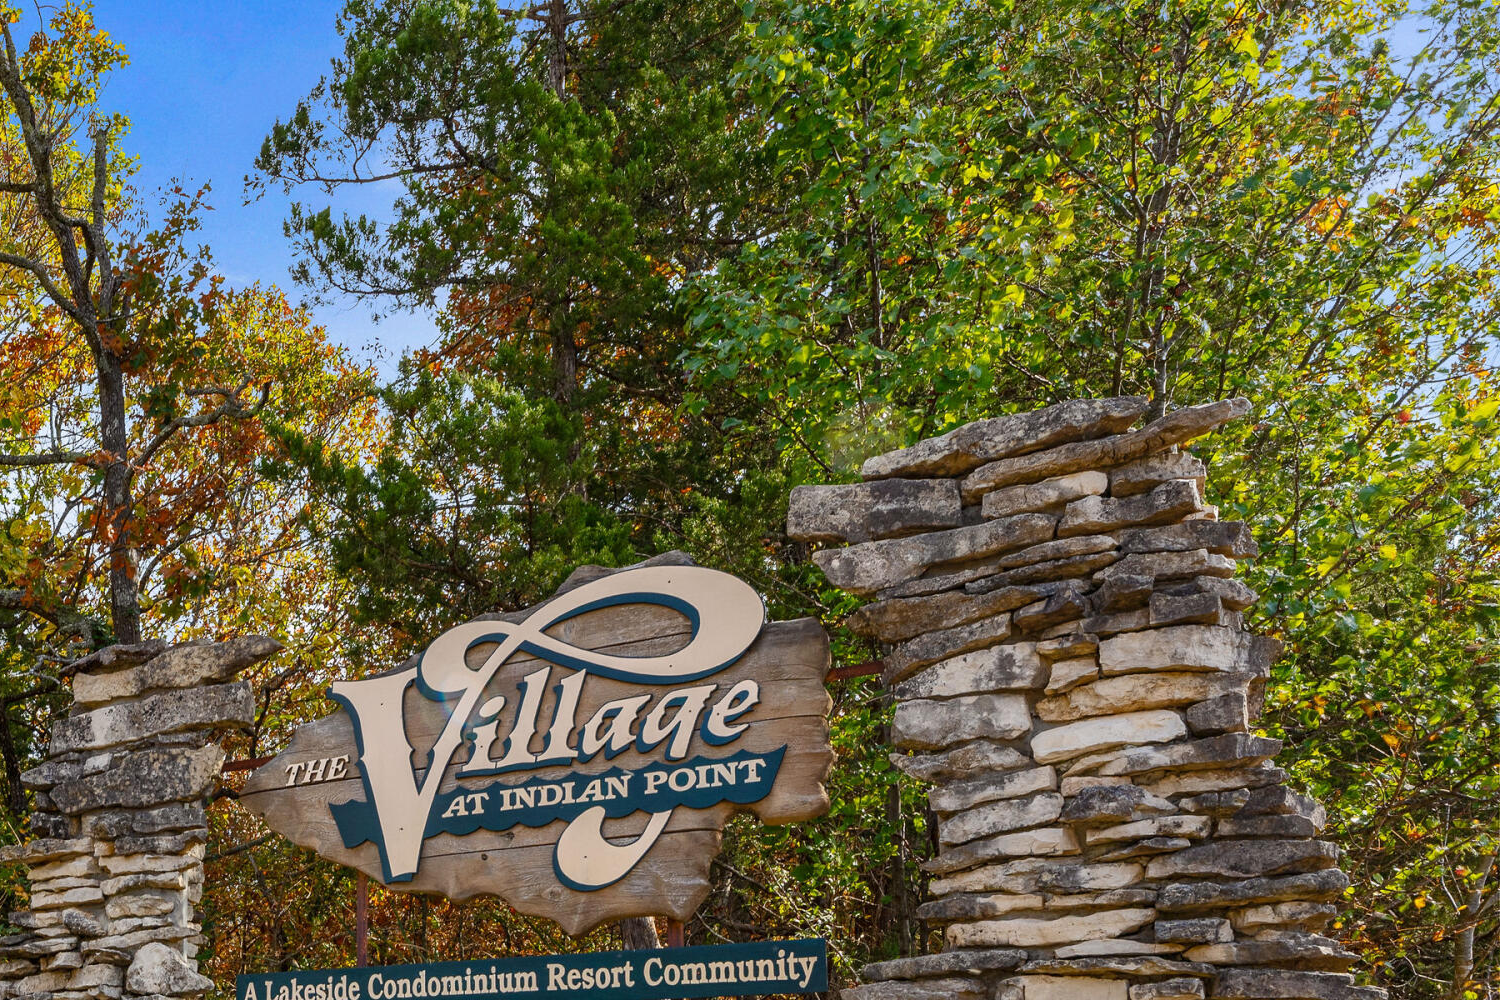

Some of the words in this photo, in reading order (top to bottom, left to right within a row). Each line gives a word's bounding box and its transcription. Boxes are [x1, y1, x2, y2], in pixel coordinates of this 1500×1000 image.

[285, 754, 350, 787] THE
[332, 566, 767, 890] Village
[441, 793, 489, 818] AT
[499, 774, 632, 811] INDIAN
[643, 757, 767, 796] POINT
[367, 966, 540, 1000] Condominium
[546, 961, 635, 991] Resort
[643, 949, 818, 988] Community
